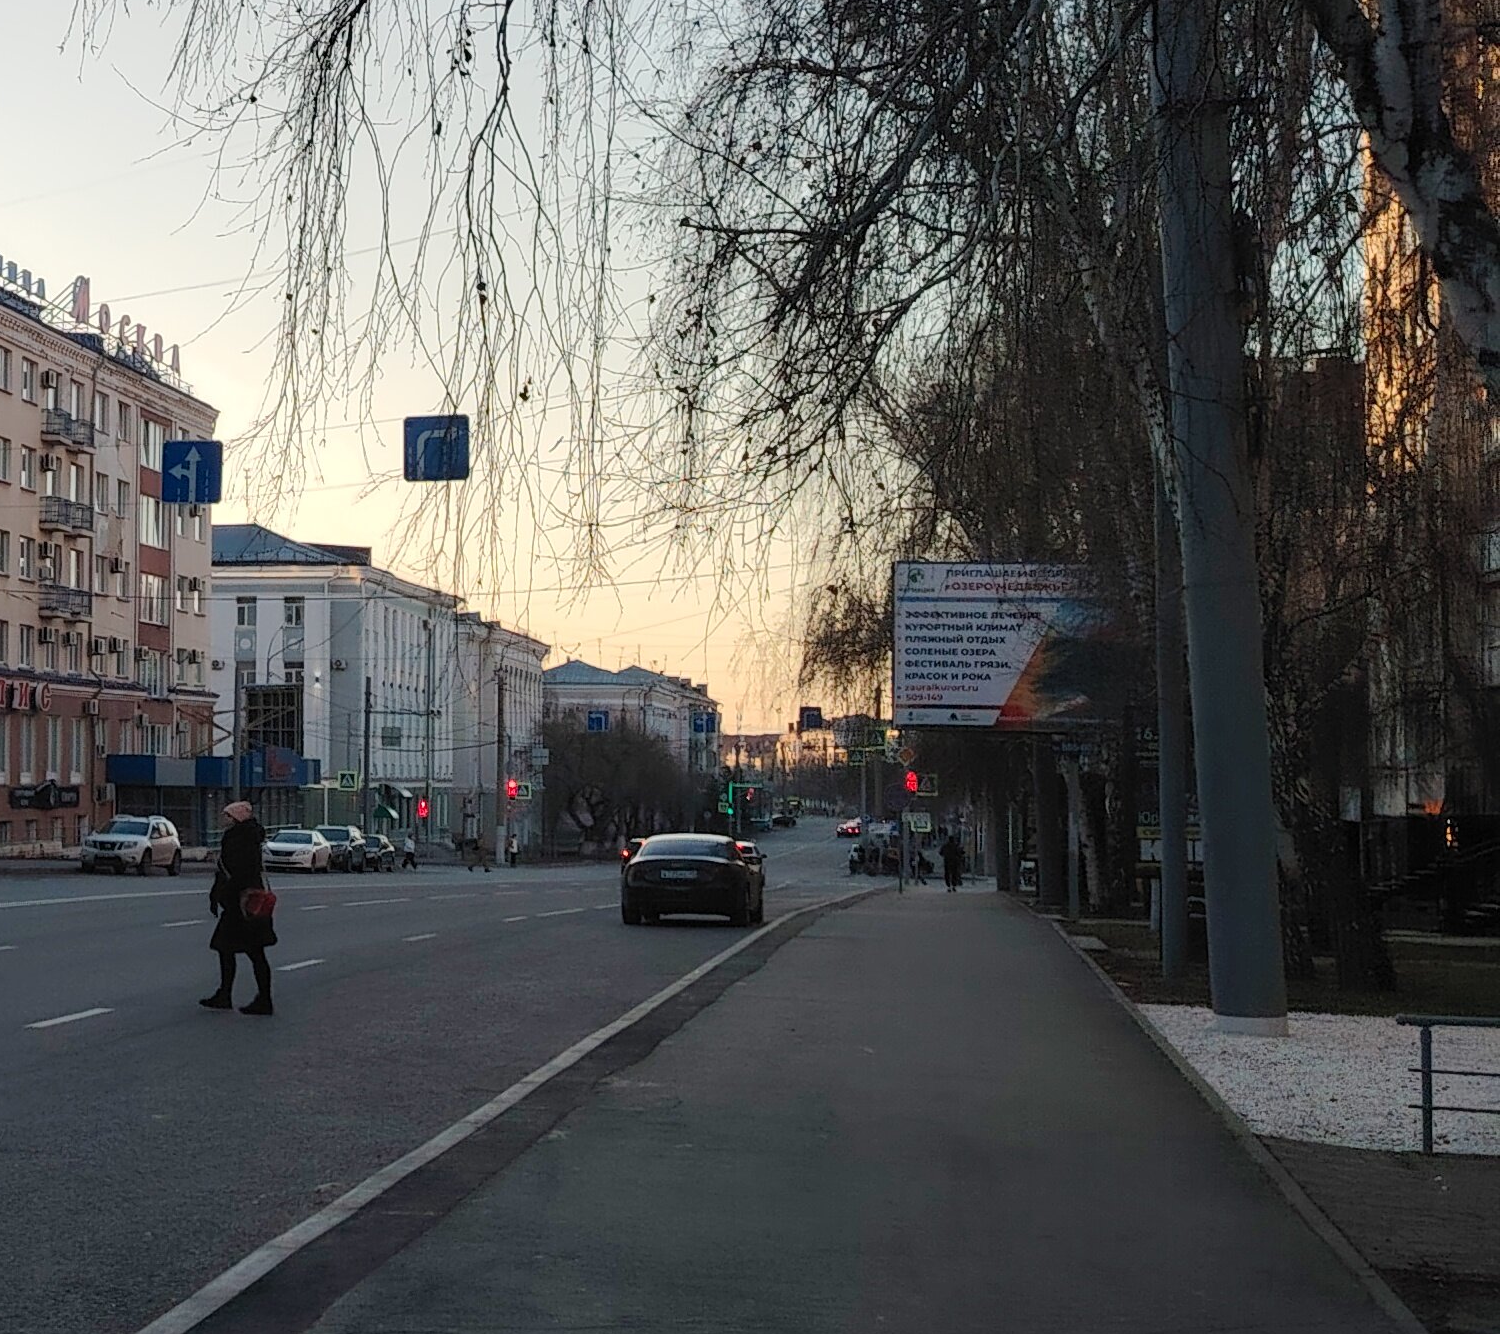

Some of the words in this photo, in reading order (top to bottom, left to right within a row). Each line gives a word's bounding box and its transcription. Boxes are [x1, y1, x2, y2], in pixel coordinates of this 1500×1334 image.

[905, 611, 988, 620] ЭФФЕКТИВНОЕ
[905, 622, 973, 632] КУРОРТНЫЙ
[976, 623, 1023, 632] КЛИМАТ
[905, 634, 963, 644] ПЛЯЖНЫЙ
[967, 635, 1006, 645] ОТДЫХ
[905, 648, 958, 656] СОЛЕНЫЕ
[961, 648, 996, 656] ОЗЕРА
[905, 660, 971, 669] ФЕСТИВАЛЬ
[905, 672, 948, 681] КРАСОК
[951, 672, 959, 681] И
[962, 672, 992, 681] РОКА
